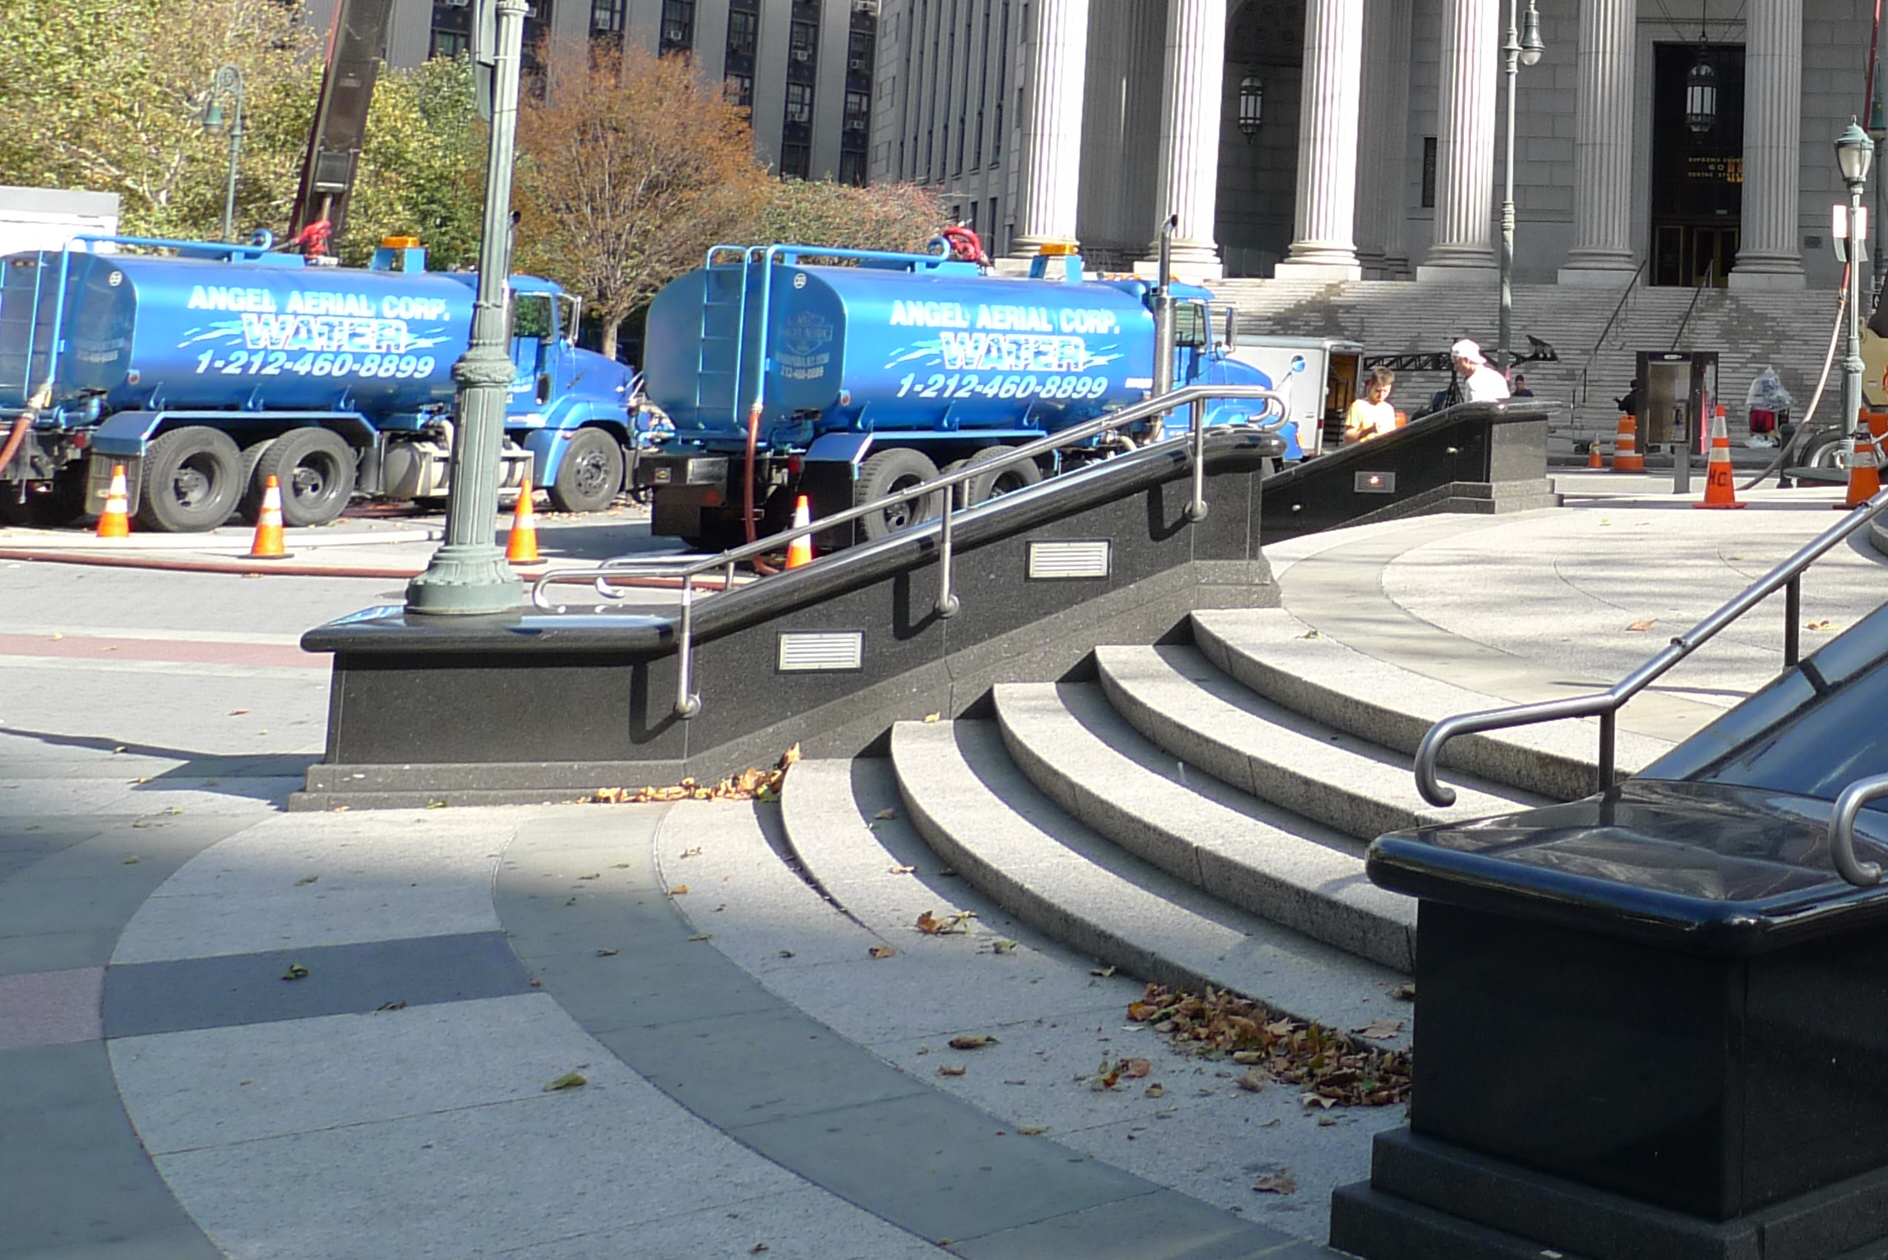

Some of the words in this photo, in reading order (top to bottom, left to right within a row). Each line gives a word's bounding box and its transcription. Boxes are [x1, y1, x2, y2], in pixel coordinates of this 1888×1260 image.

[187, 285, 277, 313] ANGEL
[286, 290, 376, 318] AERIAL
[381, 295, 451, 322] CORP.
[889, 300, 970, 328] ANGEL
[976, 304, 1054, 332] AERIAL
[1058, 308, 1121, 334] CORP.
[240, 312, 409, 354] WATER
[195, 348, 436, 379] 1-212-460-8899
[939, 332, 1086, 372] WATER
[896, 372, 1109, 399] 1-212-460-8899
